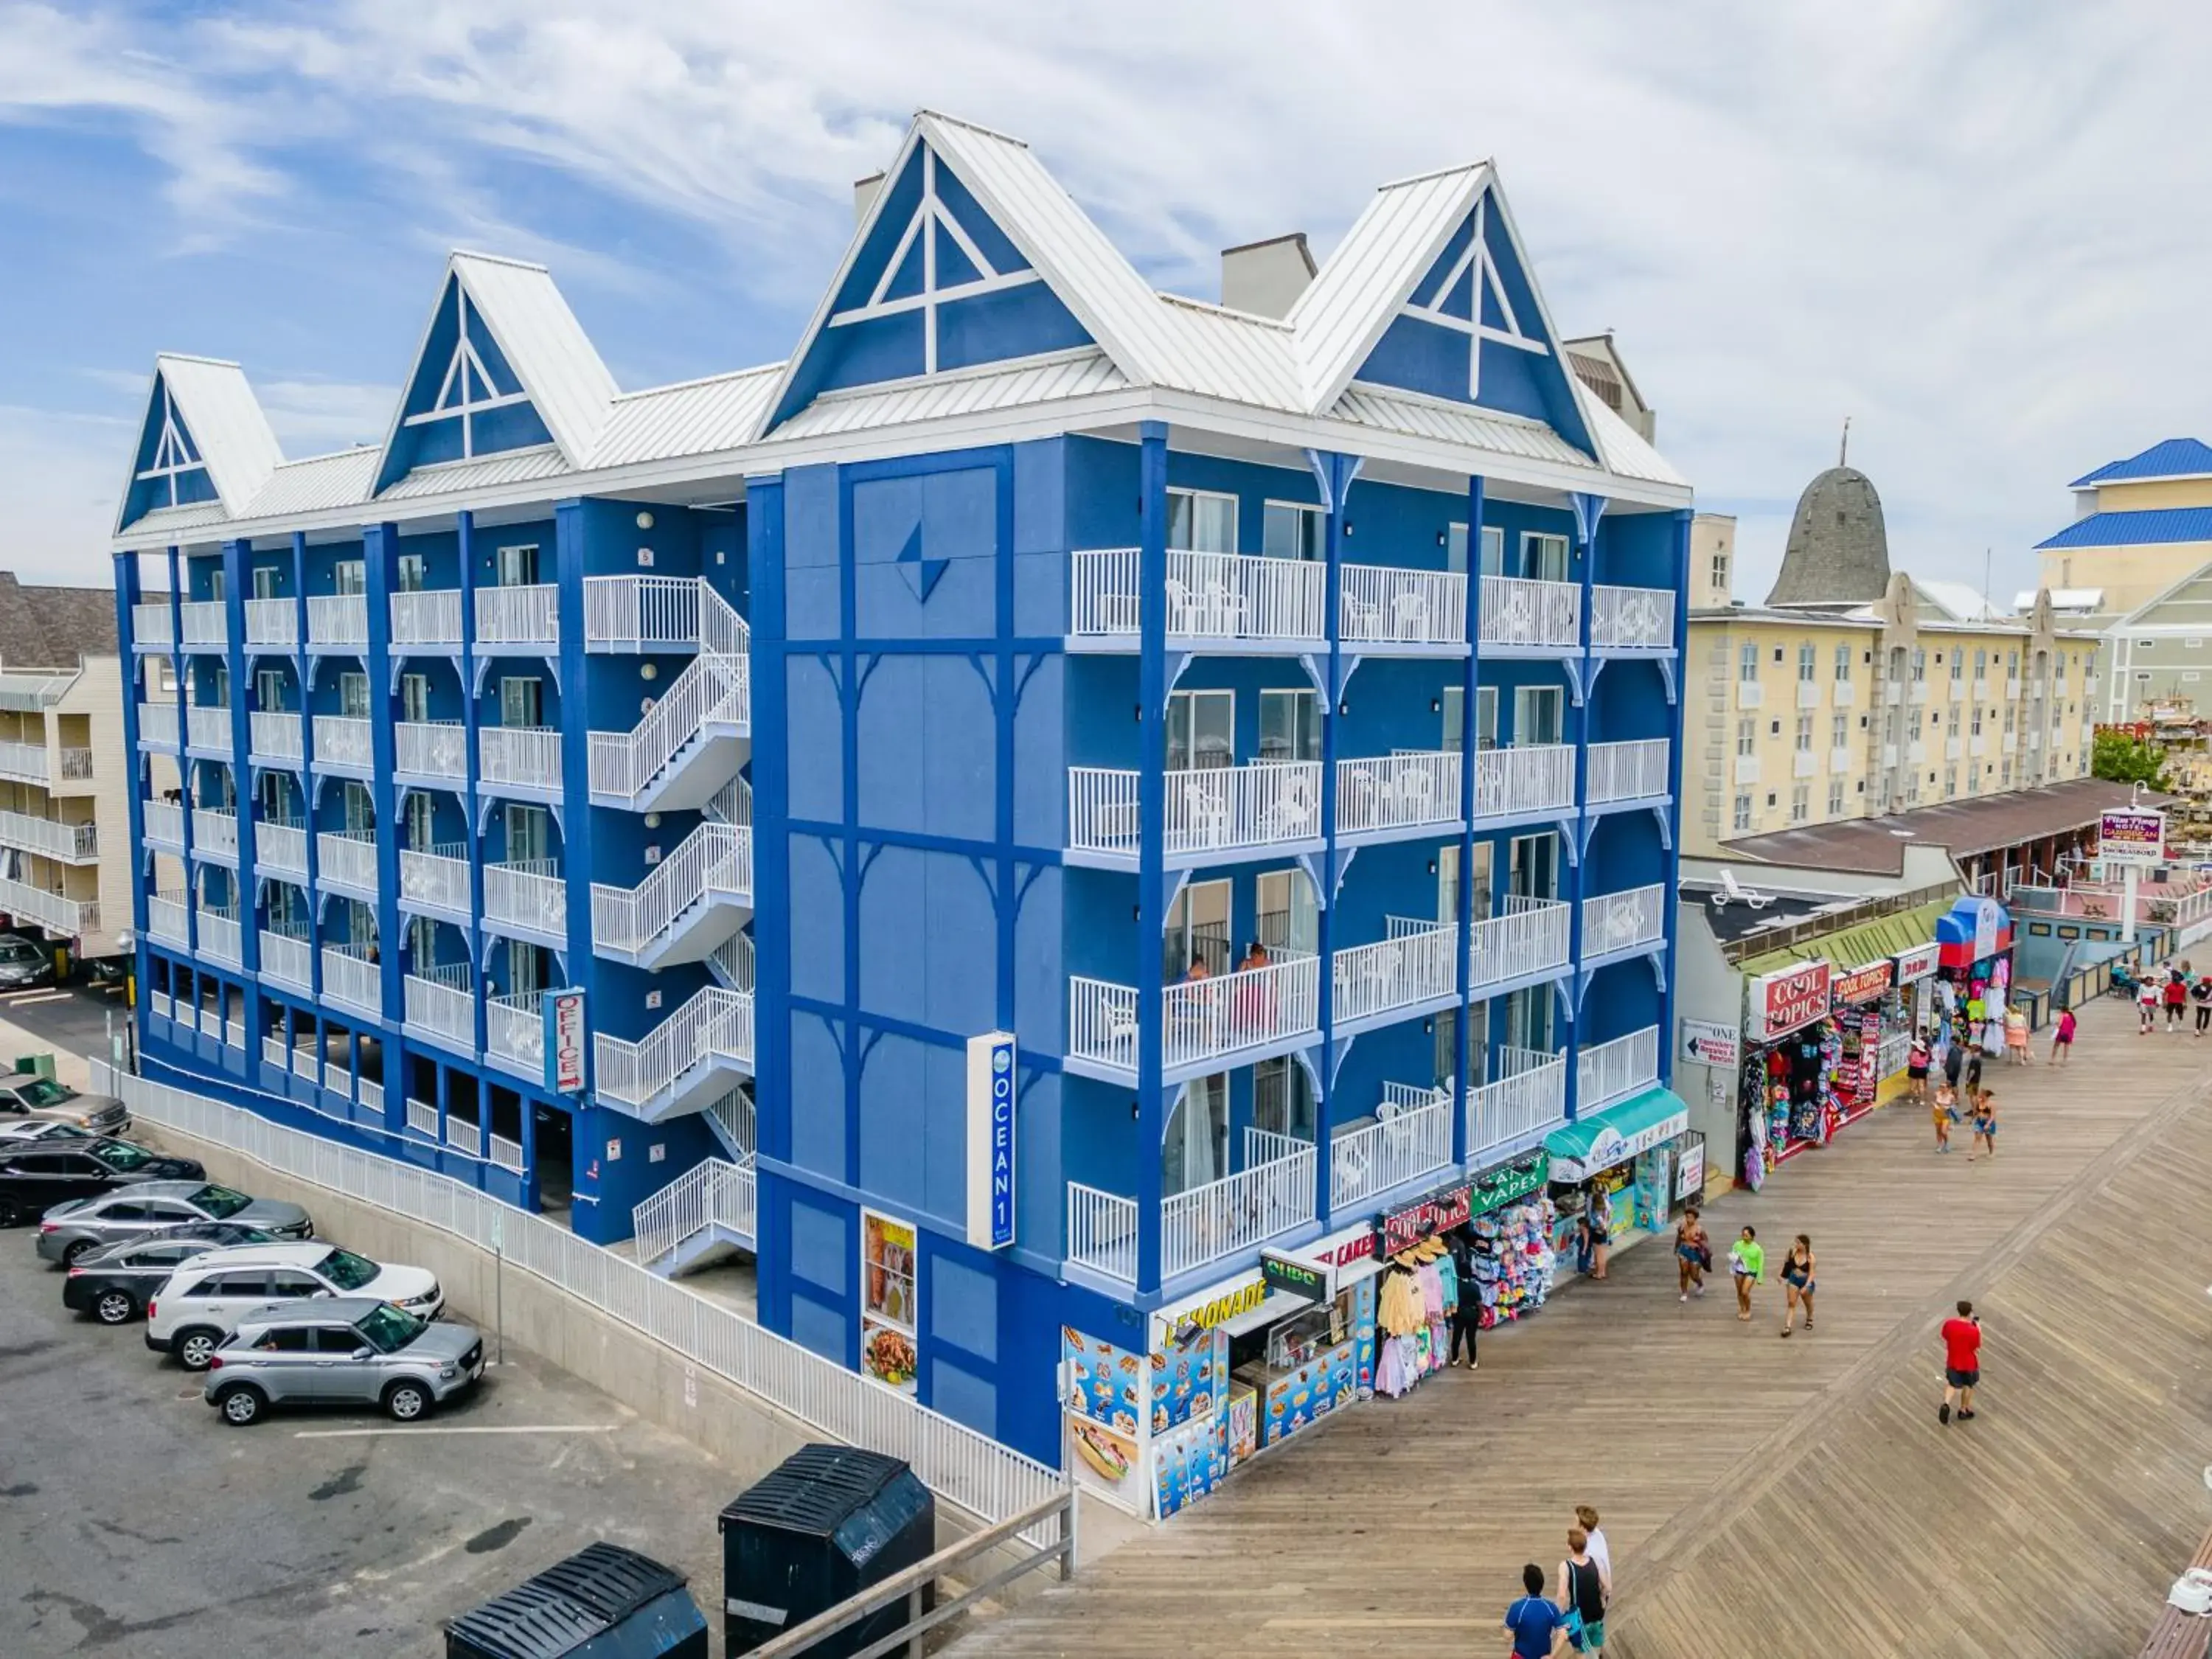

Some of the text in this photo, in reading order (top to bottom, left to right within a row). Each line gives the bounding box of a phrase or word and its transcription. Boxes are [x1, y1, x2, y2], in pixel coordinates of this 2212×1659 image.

[2115, 823, 2146, 831] HOTEL
[1774, 970, 1821, 1004] COOL
[1770, 990, 1826, 1032] TOPICS
[557, 996, 579, 1074] OFFICE
[1713, 1028, 1737, 1040] ONE
[994, 1077, 1009, 1195] OCEAN
[1481, 1175, 1537, 1206] VAPES
[998, 1201, 1005, 1225] 1
